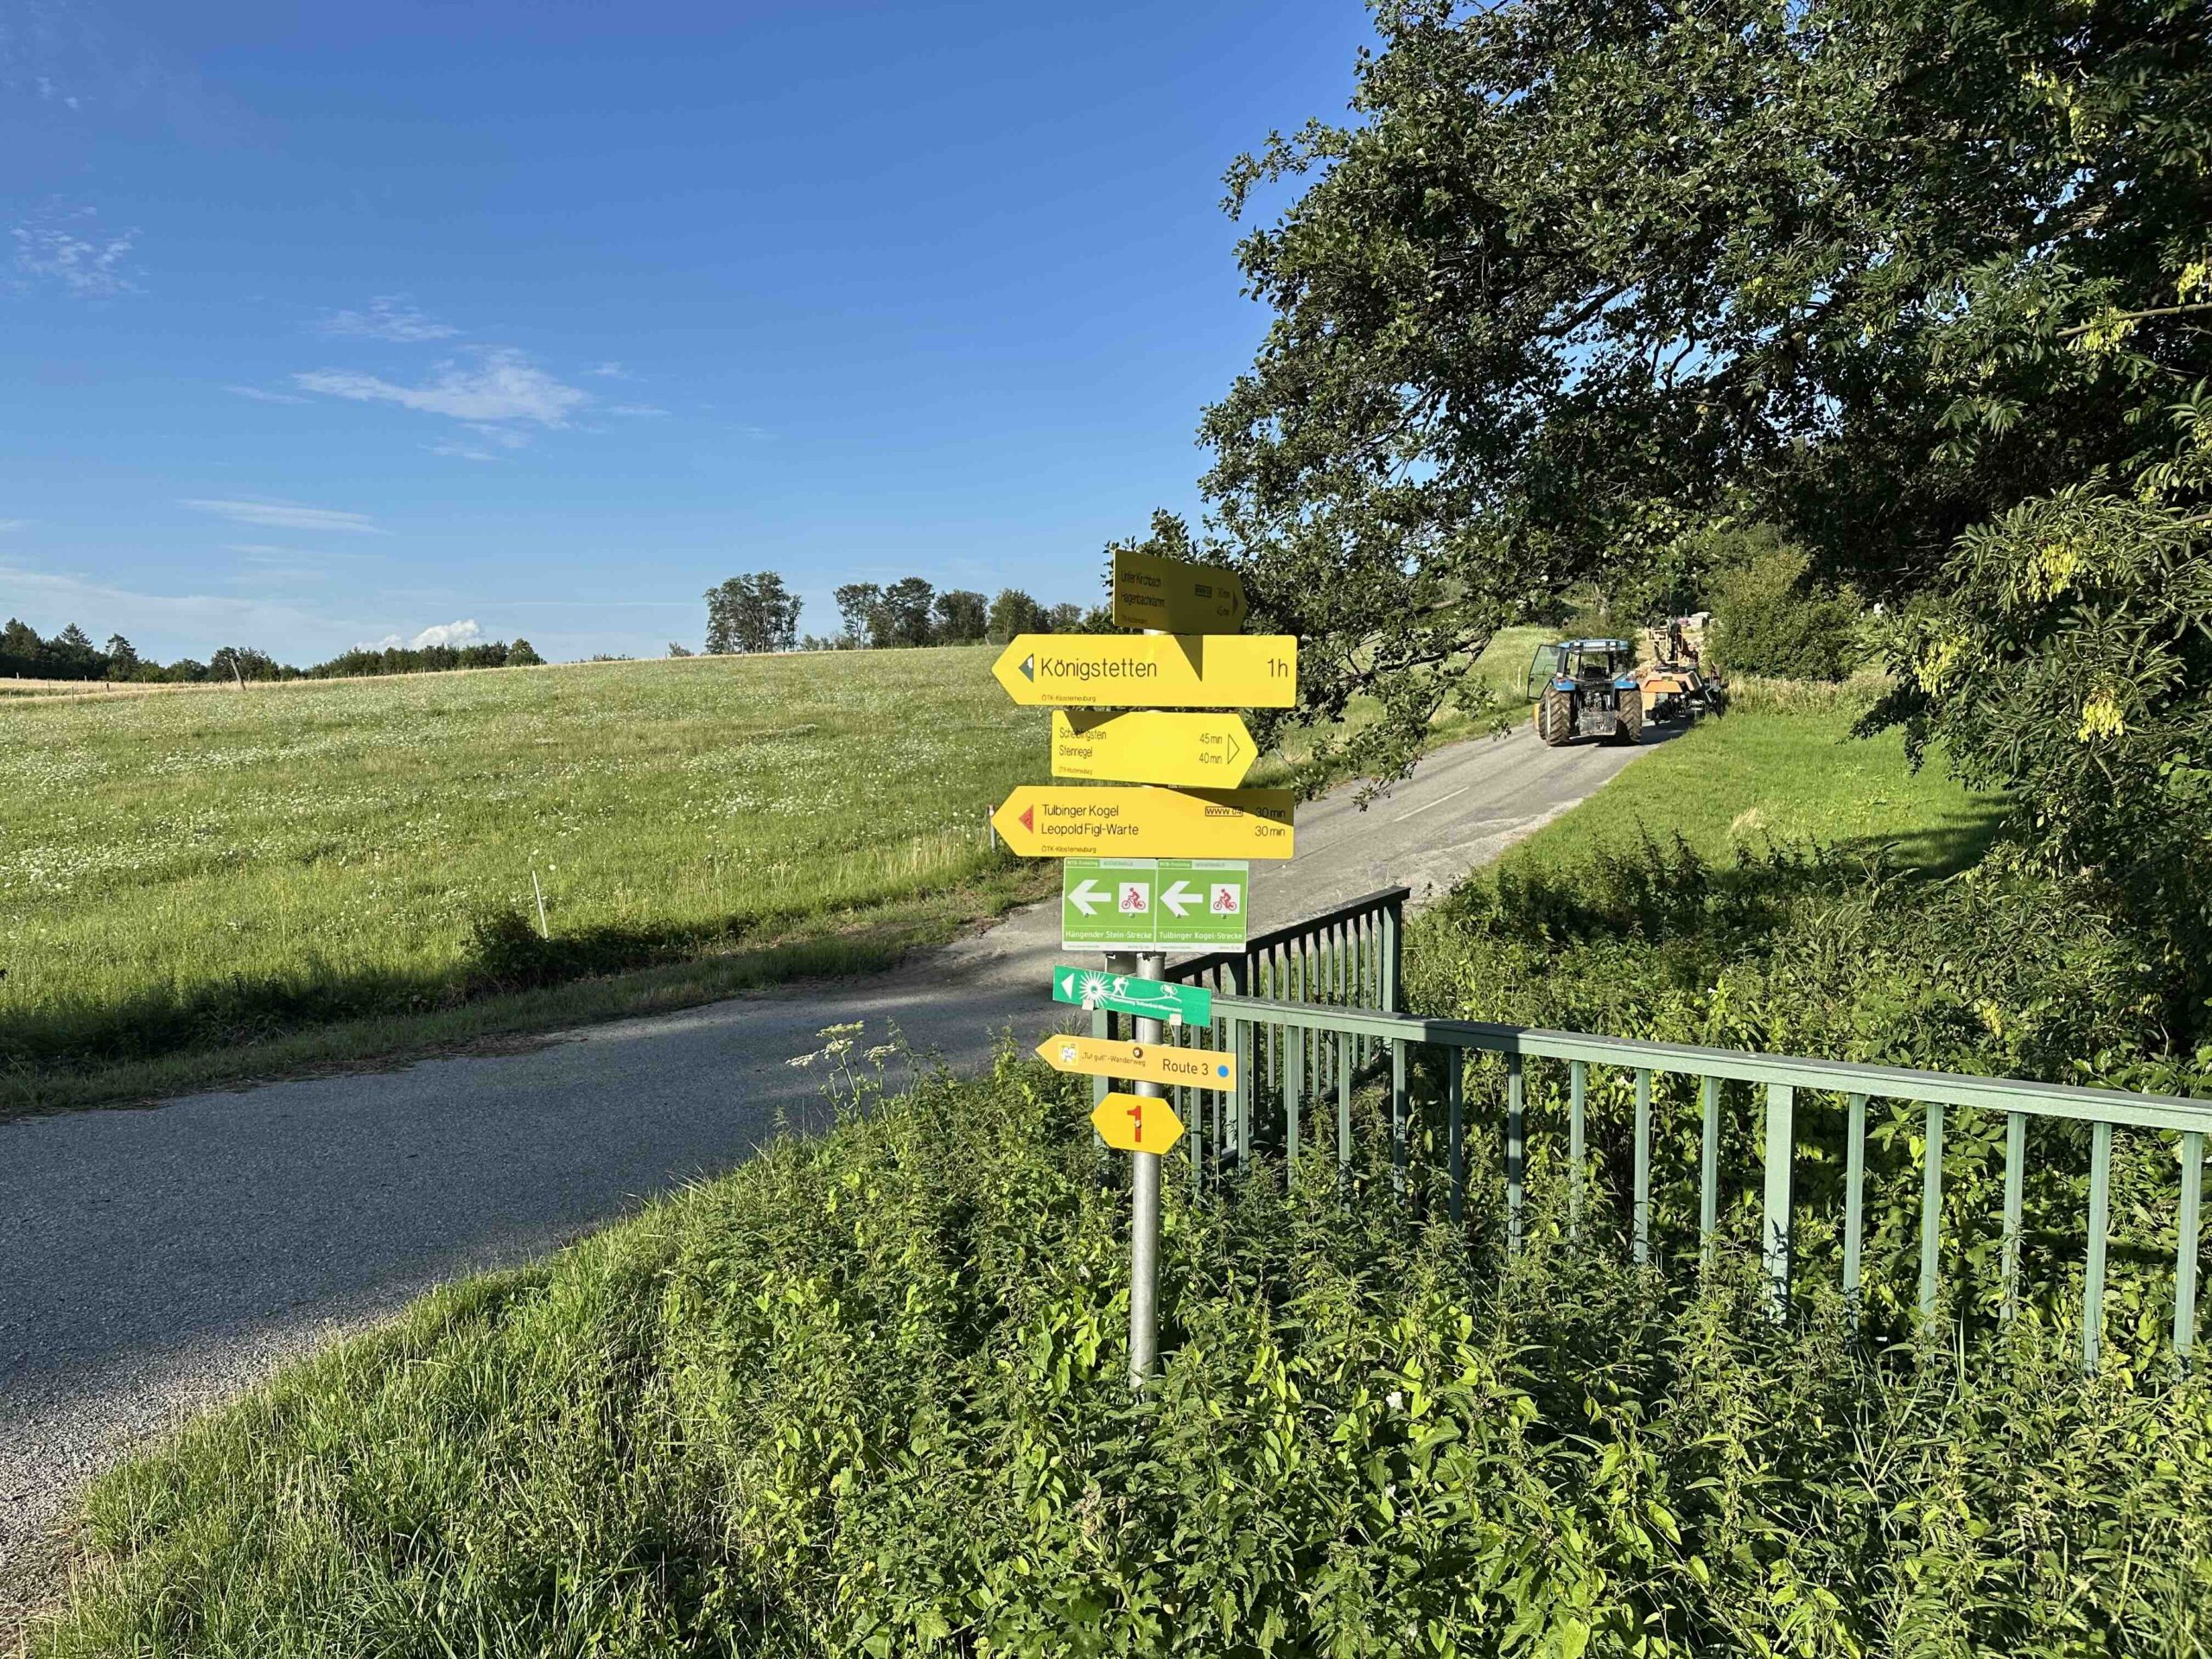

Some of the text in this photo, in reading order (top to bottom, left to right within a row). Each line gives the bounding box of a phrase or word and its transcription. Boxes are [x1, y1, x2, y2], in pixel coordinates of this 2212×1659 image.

[1040, 658, 1157, 681] Königstetten
[1267, 658, 1288, 677] 1h
[1059, 727, 1107, 741] Scheiblingstein
[1199, 733, 1223, 745] 45 min
[1198, 752, 1223, 765] 40 min
[1042, 804, 1119, 819] Tulbinger Kogel
[1255, 807, 1286, 818] 30 min
[1041, 823, 1139, 837] Leopold Figl-Warte
[1255, 825, 1286, 836] 30 min
[1065, 930, 1103, 940] Hängender
[1160, 931, 1243, 941] Tulbinger Kogel-Strecke
[1162, 1058, 1209, 1076] Route 3
[1127, 1105, 1141, 1143] 1
